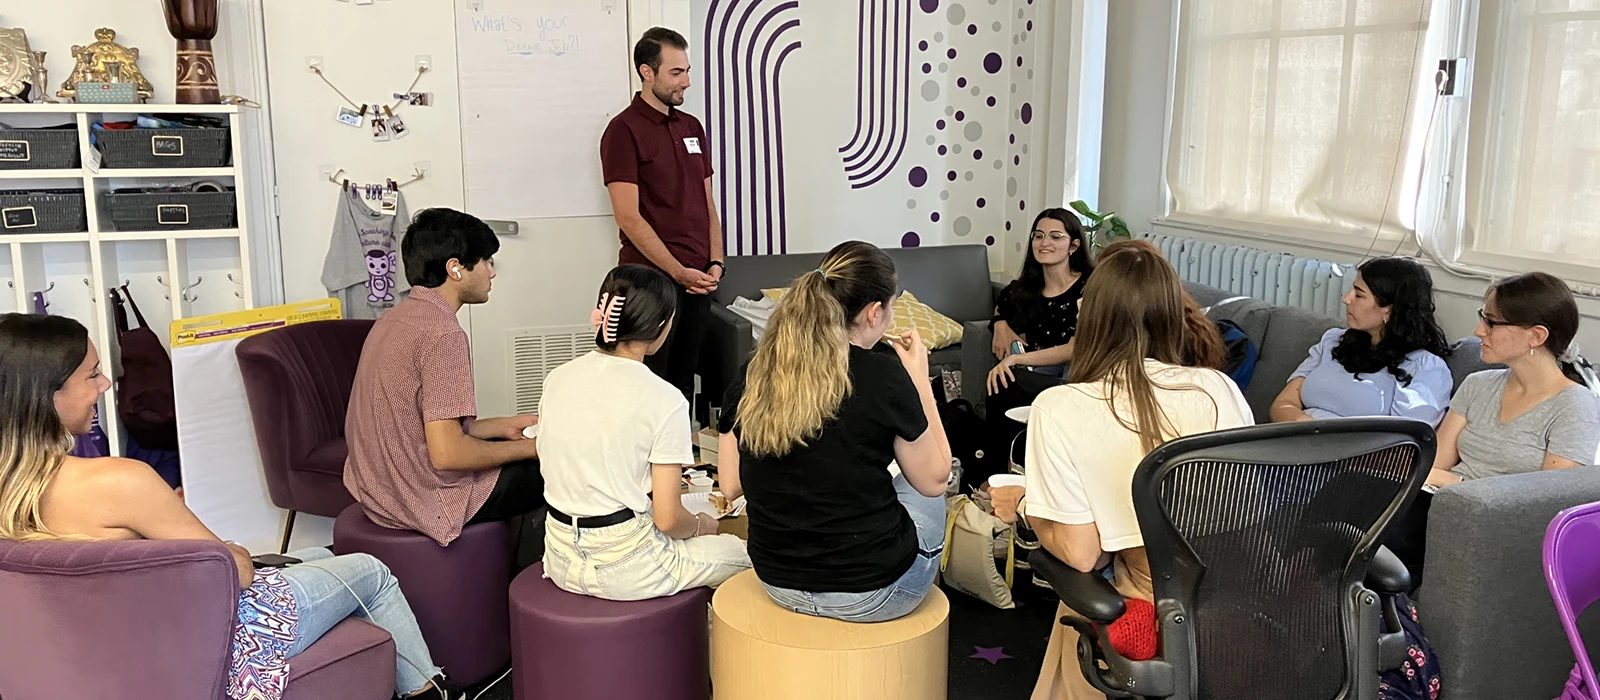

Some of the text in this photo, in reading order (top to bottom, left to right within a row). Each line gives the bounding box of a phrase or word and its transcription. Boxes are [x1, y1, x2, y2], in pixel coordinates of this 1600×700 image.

[471, 14, 568, 42] What's your
[155, 140, 177, 151] BAGS
